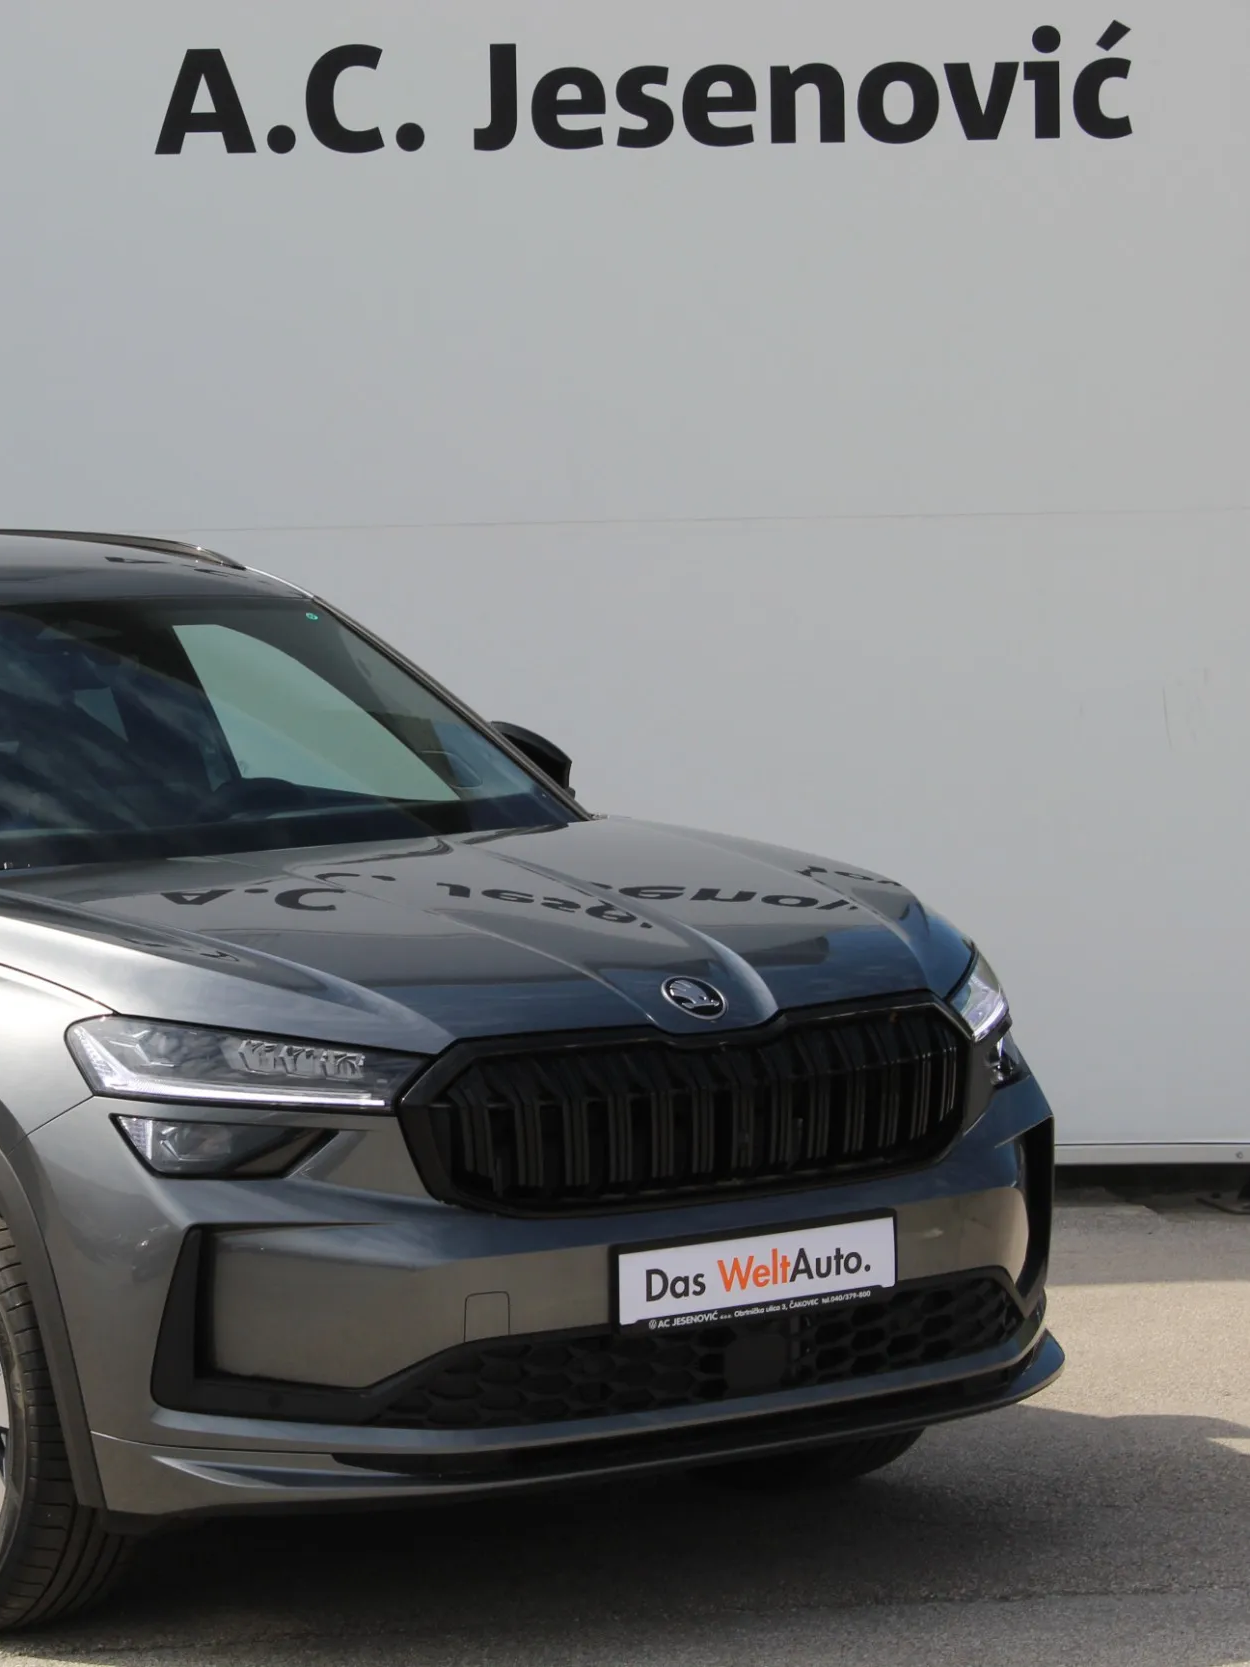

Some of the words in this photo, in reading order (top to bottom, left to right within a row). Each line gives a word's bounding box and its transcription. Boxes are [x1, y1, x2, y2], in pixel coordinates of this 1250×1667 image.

[155, 44, 425, 154] A.C.
[474, 20, 1133, 152] Jesenović
[646, 1268, 706, 1302] Das
[717, 1248, 871, 1293] WeltAuto.
[672, 1310, 719, 1327] JESENOVIĆ
[789, 1297, 819, 1309] ČAKOVEC
